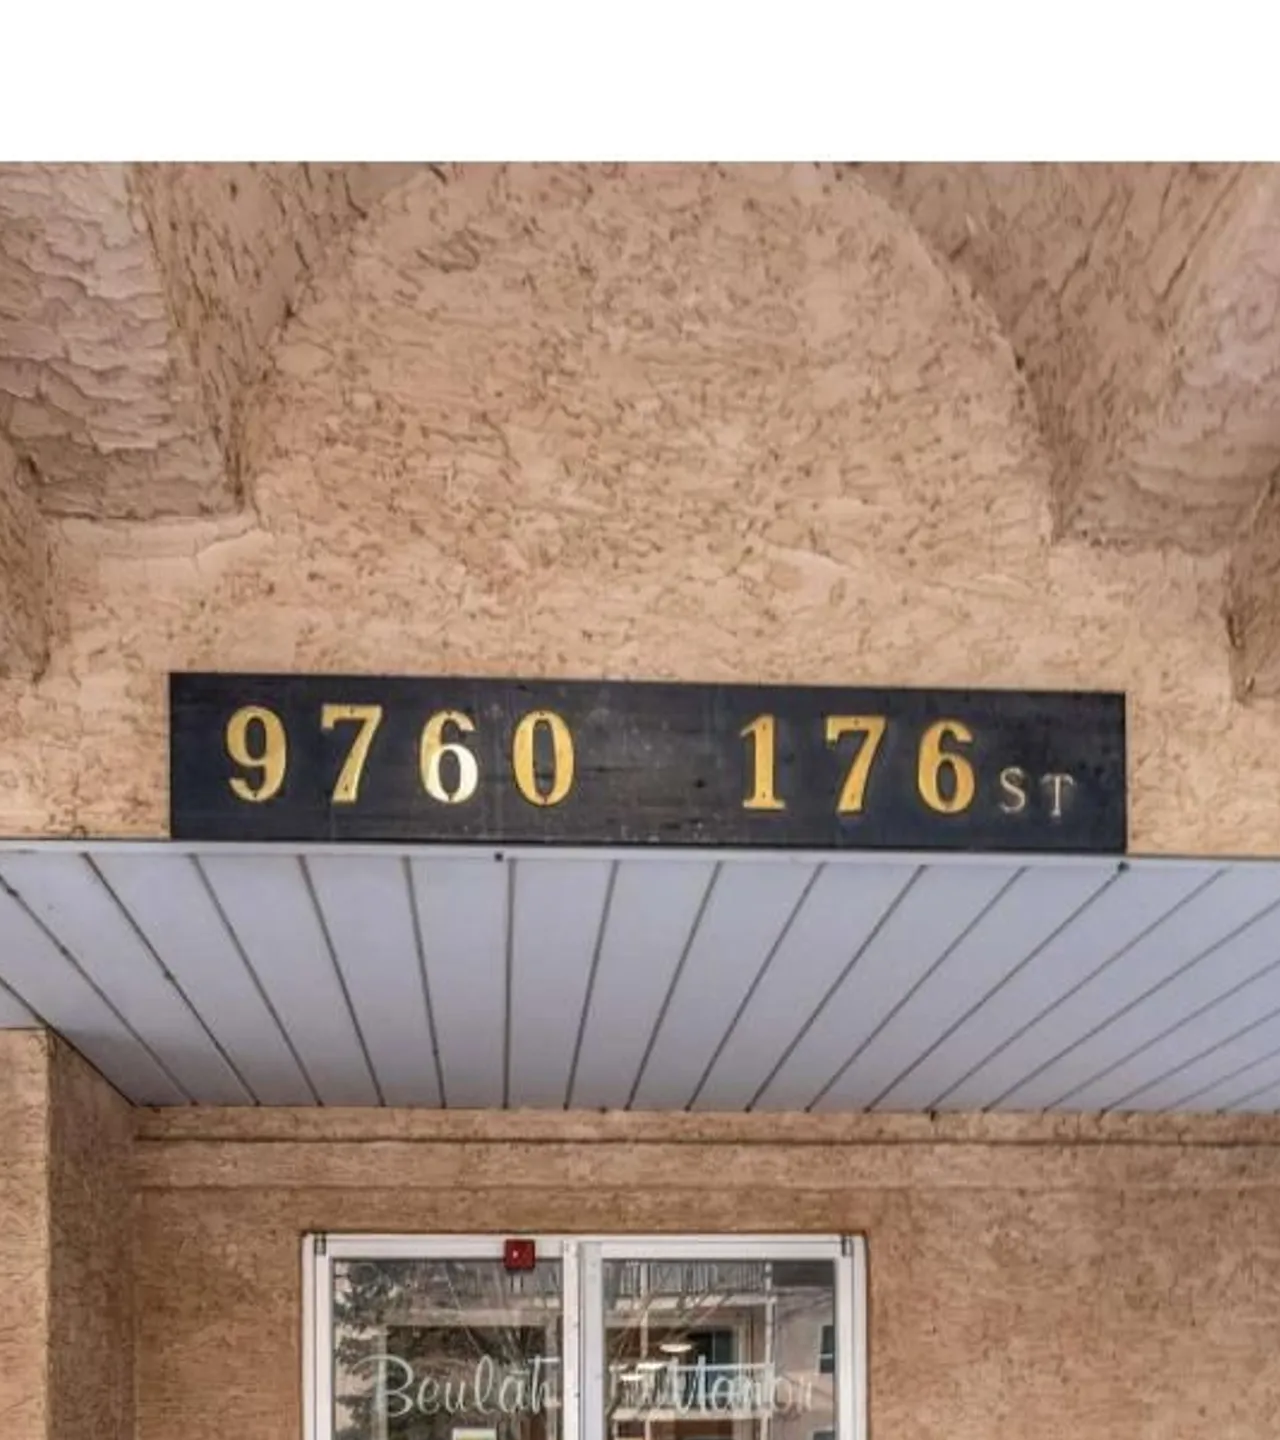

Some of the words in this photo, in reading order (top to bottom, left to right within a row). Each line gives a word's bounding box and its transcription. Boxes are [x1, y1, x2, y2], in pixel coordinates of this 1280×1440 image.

[225, 704, 575, 806] 9760
[739, 714, 976, 814] 176
[999, 767, 1075, 818] ST
